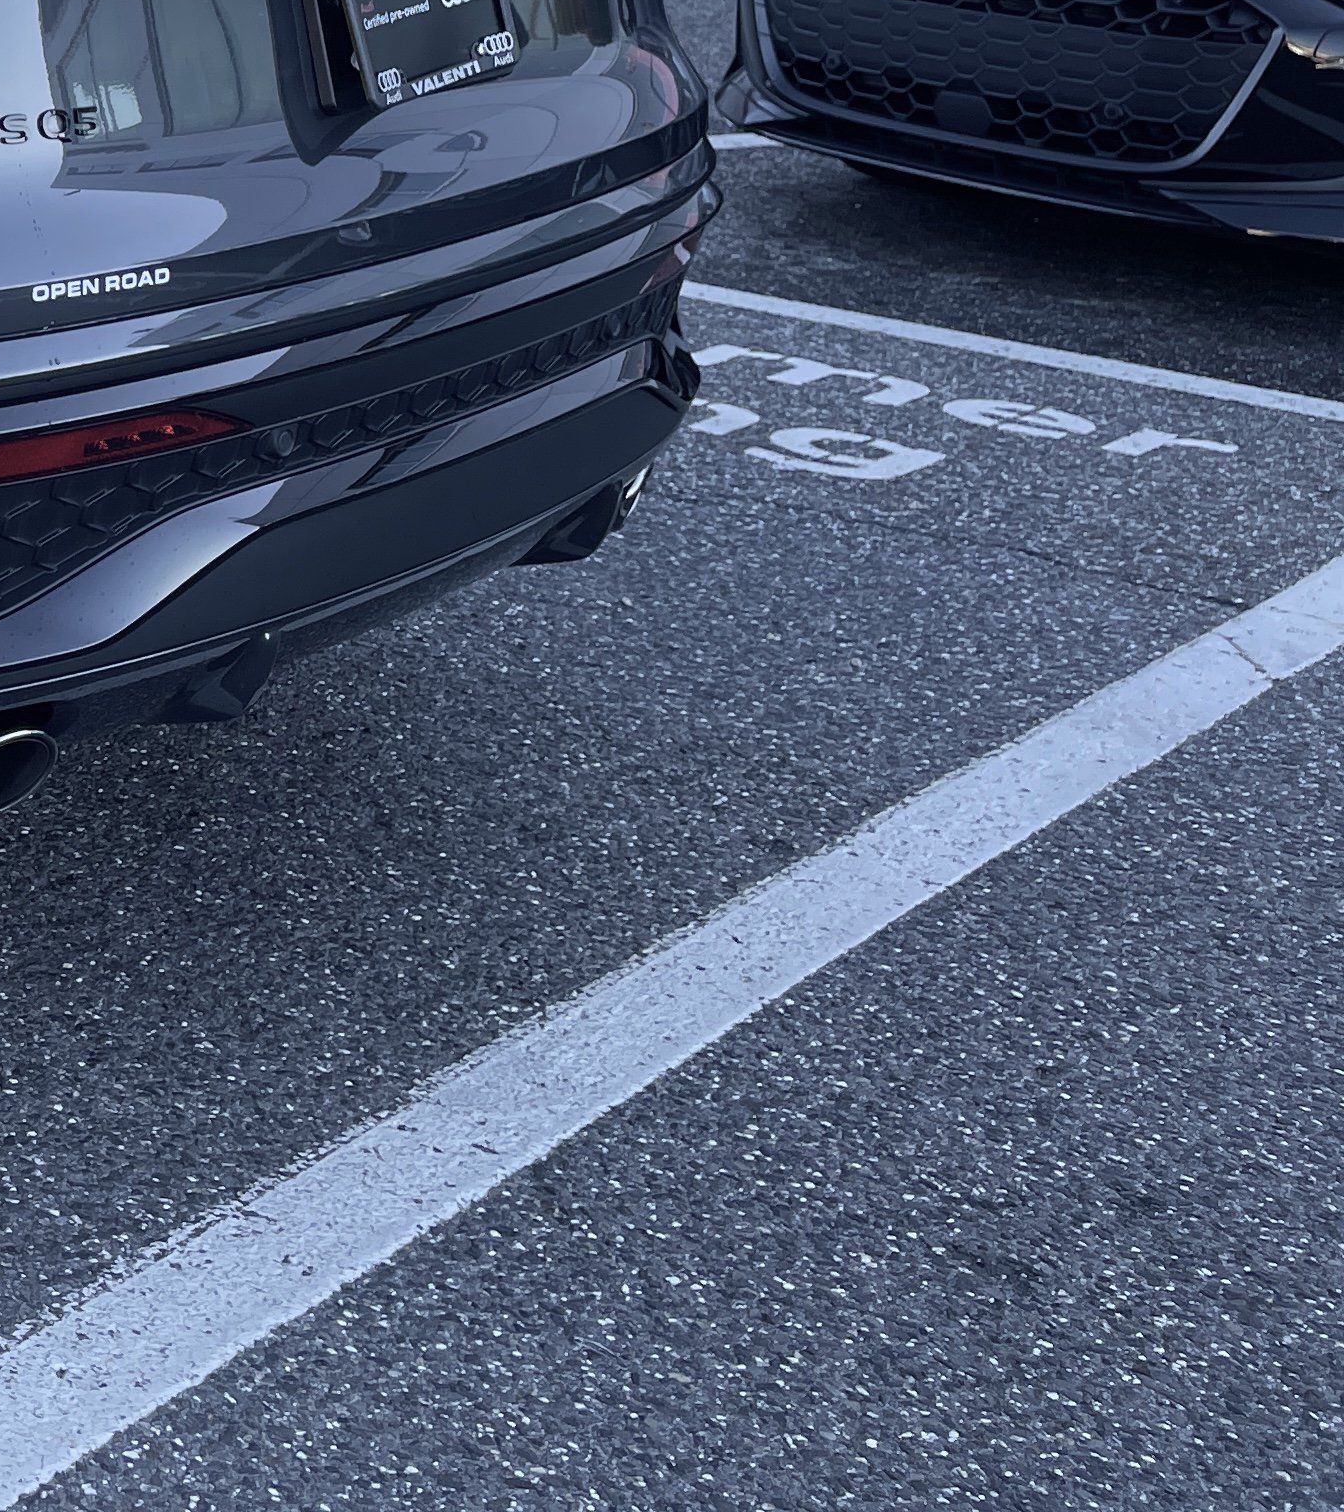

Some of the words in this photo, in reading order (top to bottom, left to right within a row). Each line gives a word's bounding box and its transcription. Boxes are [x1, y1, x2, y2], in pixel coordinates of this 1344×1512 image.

[363, 10, 390, 30] Certified
[389, 0, 430, 24] pre-owned
[494, 53, 514, 68] Audi
[412, 59, 481, 95] VALENTI
[386, 90, 403, 105] Audi
[32, 278, 100, 303] OPEN
[105, 267, 171, 293] ROAD
